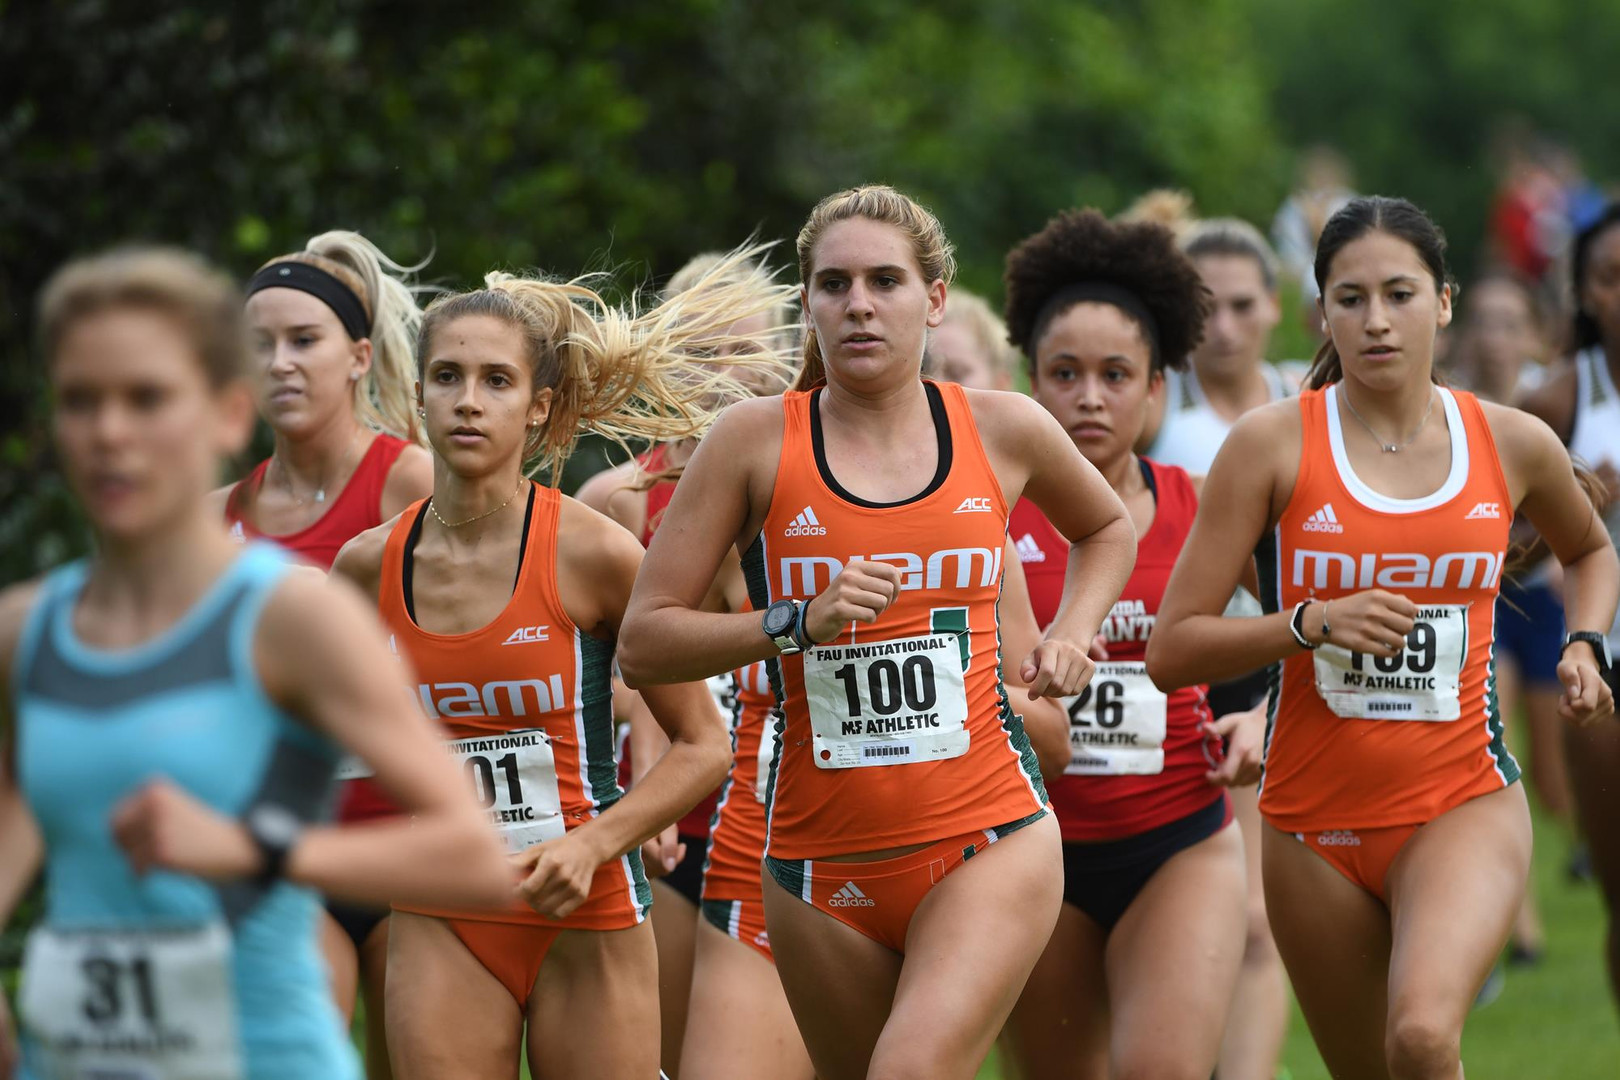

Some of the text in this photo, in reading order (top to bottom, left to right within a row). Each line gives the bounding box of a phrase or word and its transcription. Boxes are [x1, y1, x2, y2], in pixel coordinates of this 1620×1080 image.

[957, 497, 992, 511] ACC
[1468, 503, 1499, 517] ACC
[784, 525, 827, 537] adidas
[1302, 521, 1343, 534] adidas
[506, 625, 549, 642] ACC
[816, 638, 947, 662] FAU INVITATIONAL
[835, 655, 937, 718] 100
[1365, 676, 1436, 691] ATHLETIC
[866, 713, 940, 734] ATHLETIC
[1071, 731, 1138, 745] ATHLETIC
[464, 753, 524, 810] 01
[492, 806, 535, 823] LETIC
[1317, 833, 1361, 847] adidas
[828, 896, 875, 908] adidas
[81, 955, 162, 1028] 31
